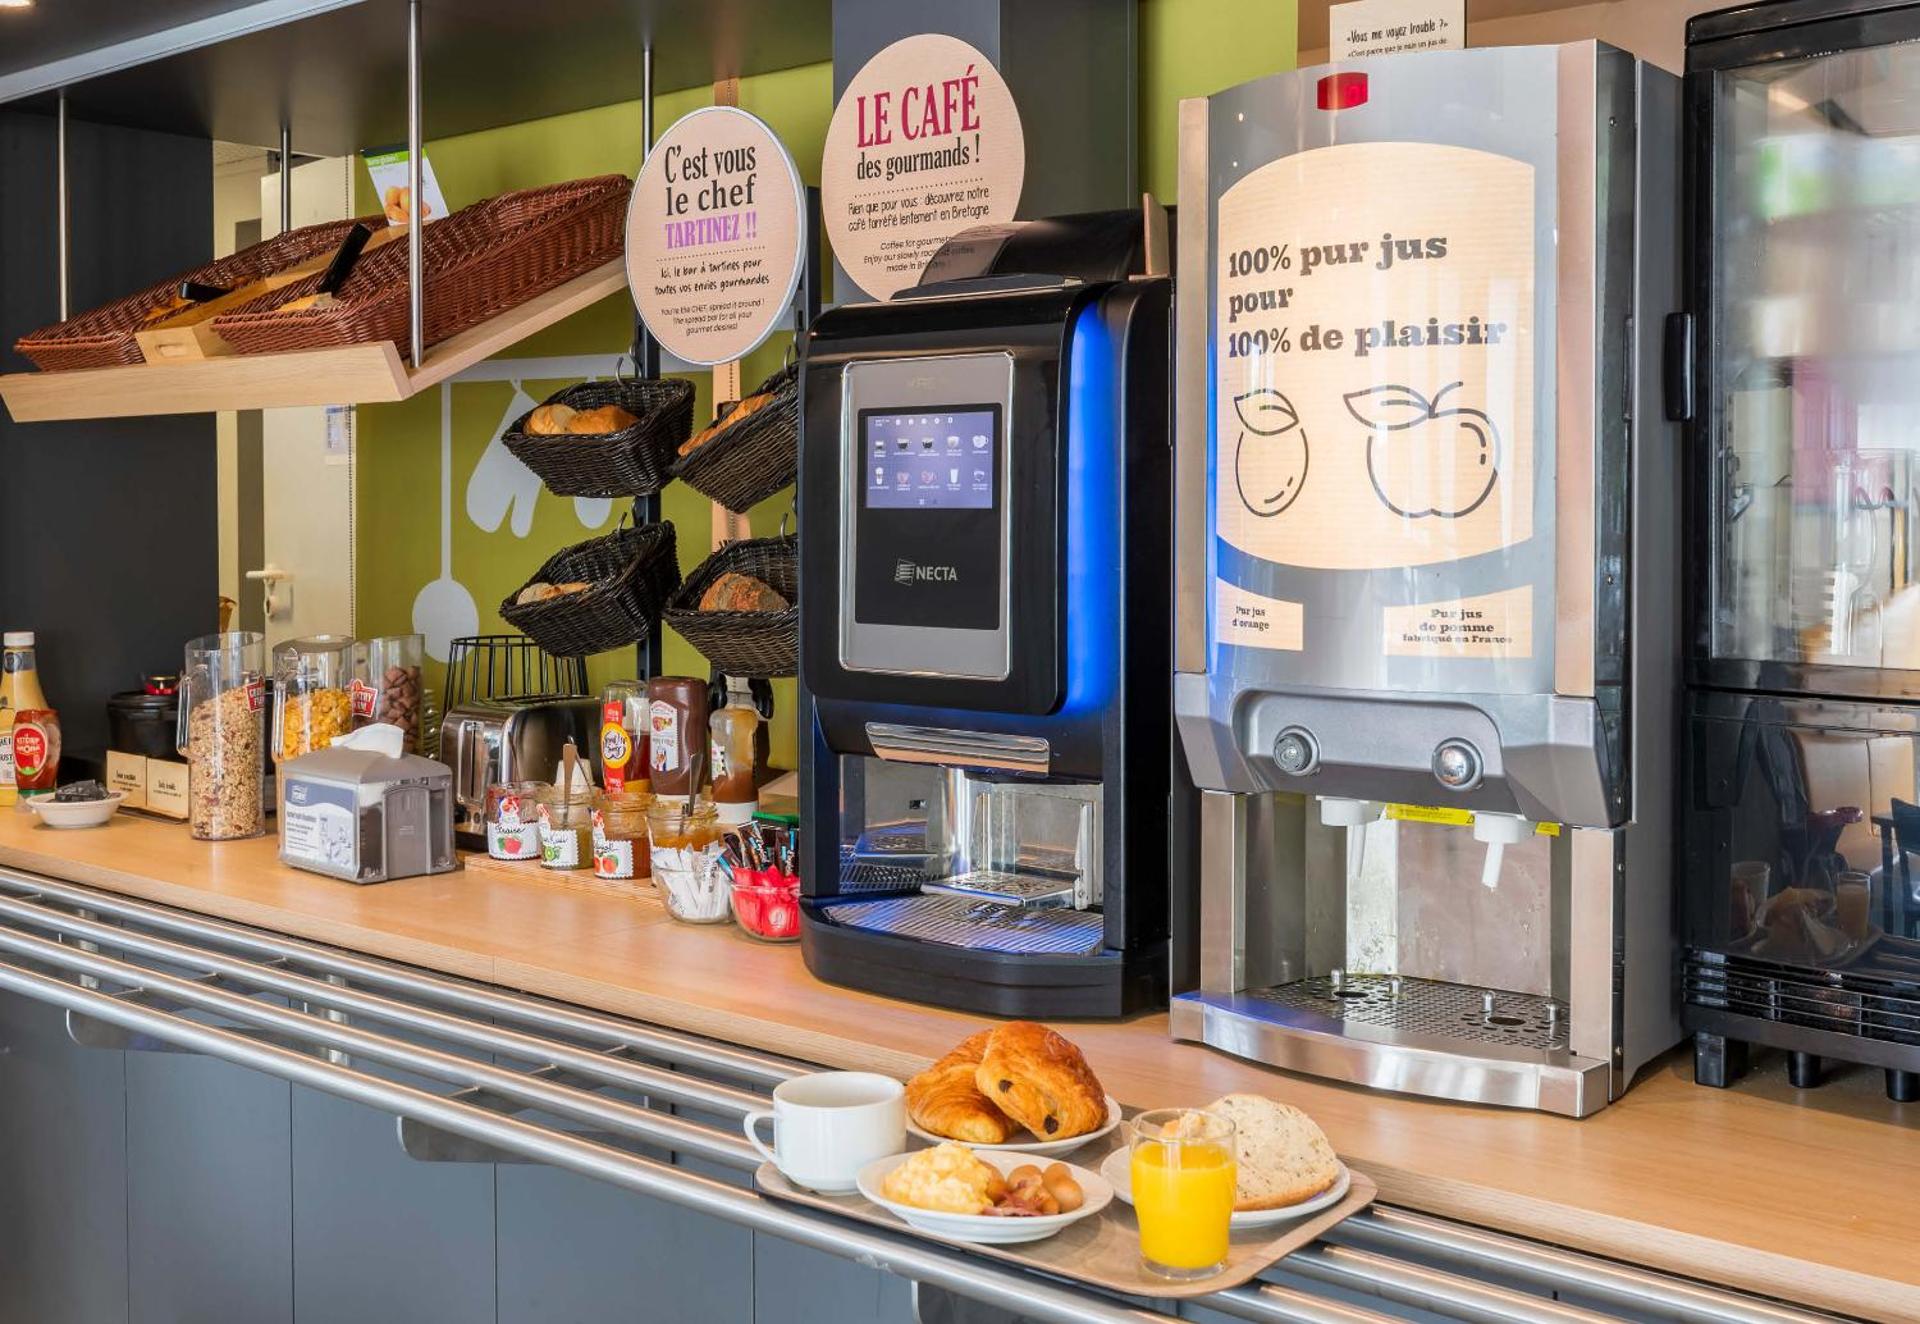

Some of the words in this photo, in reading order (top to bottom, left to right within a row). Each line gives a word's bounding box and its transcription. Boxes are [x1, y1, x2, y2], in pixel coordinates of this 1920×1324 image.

[1371, 30, 1382, 40] me
[1386, 26, 1407, 39] voyez
[857, 91, 892, 148] LE
[901, 64, 980, 141] CAFÉ
[664, 145, 708, 183] C'est
[714, 146, 756, 176] vous
[857, 151, 881, 180] des
[886, 136, 971, 181] gourmands
[975, 133, 980, 163] !
[666, 187, 688, 216] le
[698, 173, 757, 211] chef
[848, 202, 864, 216] Rien
[866, 202, 879, 217] que
[881, 200, 898, 213] pour
[900, 196, 917, 208] vous
[924, 192, 965, 206] découvrez
[967, 186, 990, 200] notre
[665, 213, 739, 249] TARTINEZ
[746, 211, 757, 239] !!
[848, 220, 866, 232] café
[900, 210, 937, 225] lentement
[940, 209, 951, 220] en
[952, 204, 990, 220] Bretagne
[674, 266, 681, 277] le
[683, 266, 697, 276] bar
[700, 261, 706, 273] à
[709, 260, 740, 272] tartines
[743, 259, 762, 273] pour
[1229, 244, 1291, 278] 100%
[1300, 240, 1369, 276] pur
[1376, 232, 1448, 271] jus
[654, 284, 676, 295] toutes
[679, 284, 692, 293] vos
[694, 280, 717, 292] envies
[720, 274, 770, 292] gourmandes
[1229, 287, 1293, 323] pour
[1229, 327, 1291, 358] 100%
[1300, 324, 1344, 351] de
[1354, 316, 1508, 357] plaisir
[916, 566, 957, 581] NECTA
[1235, 606, 1251, 616] Pur
[1251, 607, 1265, 618] jus
[1431, 608, 1458, 618] Pur
[1461, 608, 1483, 621] jus
[1419, 622, 1437, 632] de
[1440, 624, 1495, 634] pomme
[1471, 634, 1513, 643] France
